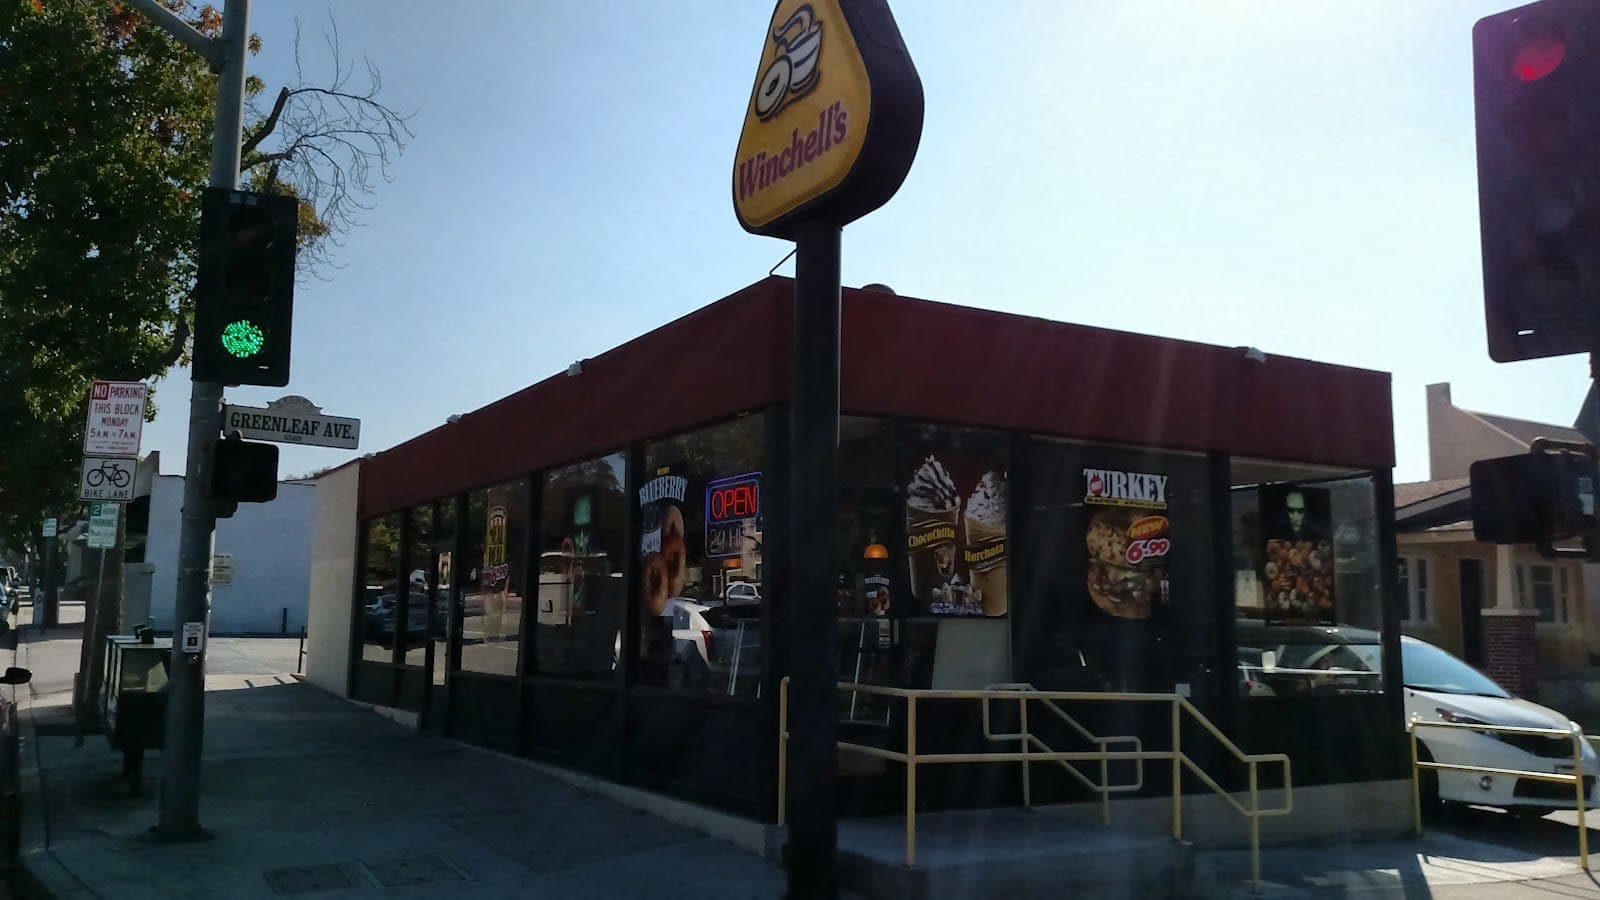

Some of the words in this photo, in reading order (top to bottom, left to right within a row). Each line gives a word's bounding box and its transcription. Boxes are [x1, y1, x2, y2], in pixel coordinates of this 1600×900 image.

[739, 101, 848, 201] Winchell's
[93, 384, 108, 399] NO
[110, 386, 144, 399] PARKING
[94, 402, 111, 415] THIS
[114, 403, 140, 415] BLOCK
[101, 416, 129, 427] MONDAY
[230, 412, 321, 436] GREENLEAF
[323, 422, 355, 440] AVE.
[84, 488, 104, 498] BIKE
[108, 490, 129, 499] LANE
[638, 475, 688, 506] BLUEBERRY
[1083, 468, 1168, 501] TURKEY
[93, 504, 101, 515] 2
[711, 485, 758, 519] OPEN
[964, 543, 1004, 563] Horchata
